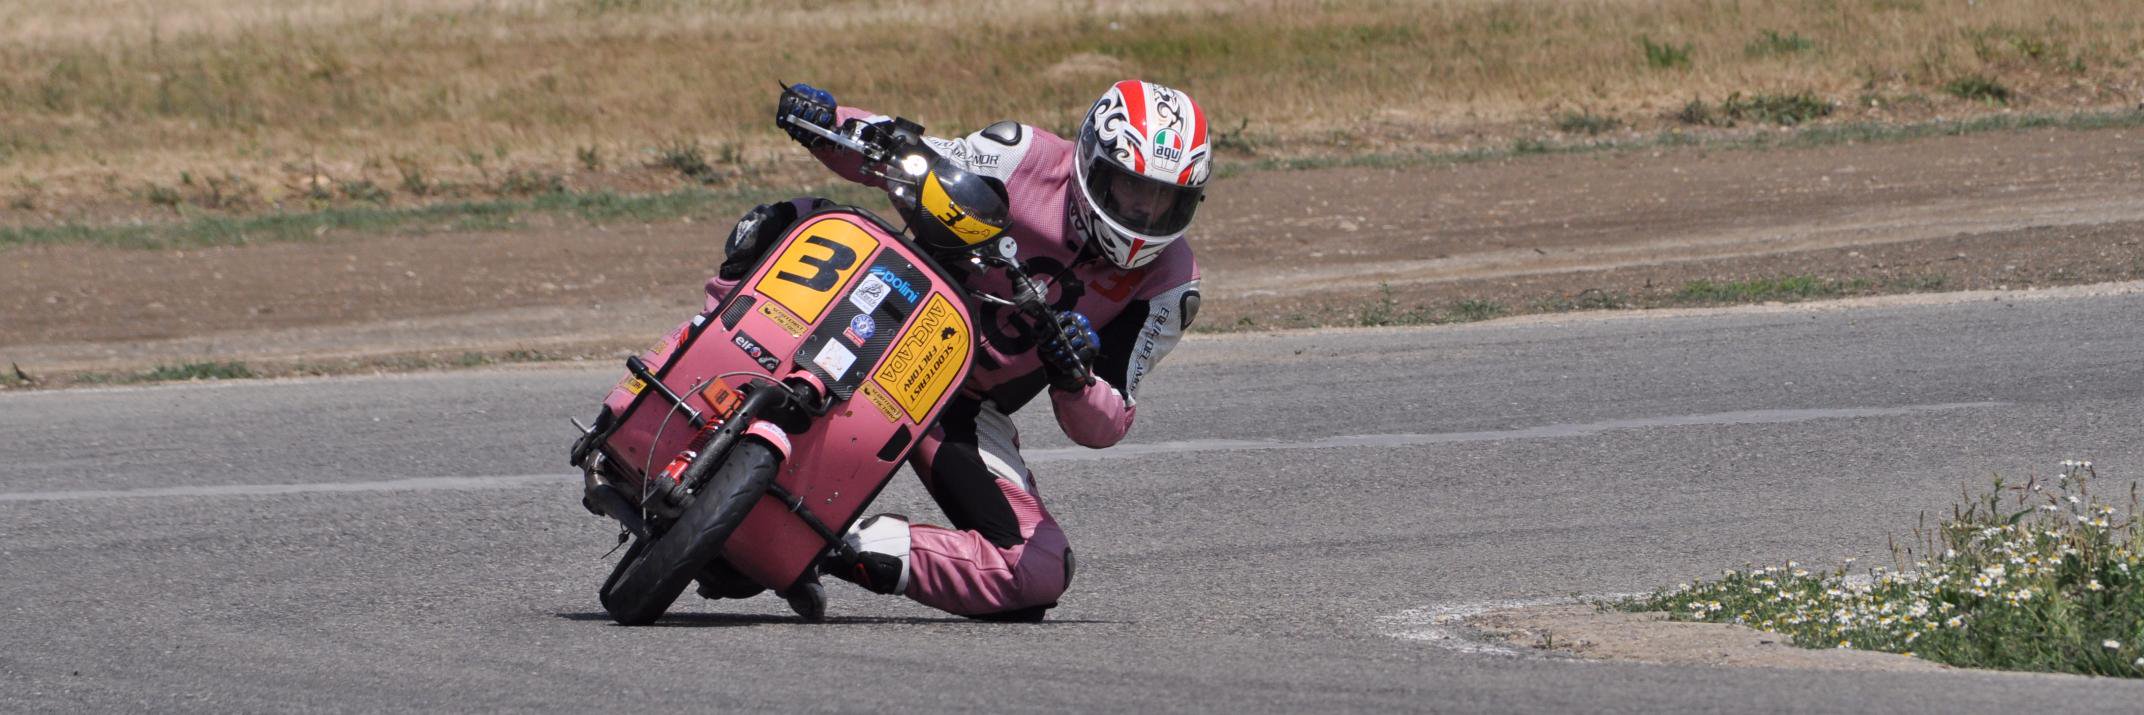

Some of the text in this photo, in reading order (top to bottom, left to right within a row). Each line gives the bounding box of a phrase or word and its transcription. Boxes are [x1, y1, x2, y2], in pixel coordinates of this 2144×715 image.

[1155, 145, 1180, 161] agv
[937, 203, 967, 226] 3
[776, 235, 857, 293] 3
[881, 269, 920, 304] polini
[735, 336, 755, 350] elf
[903, 345, 938, 393] FACTORY
[910, 343, 954, 403] SCOOTERIST
